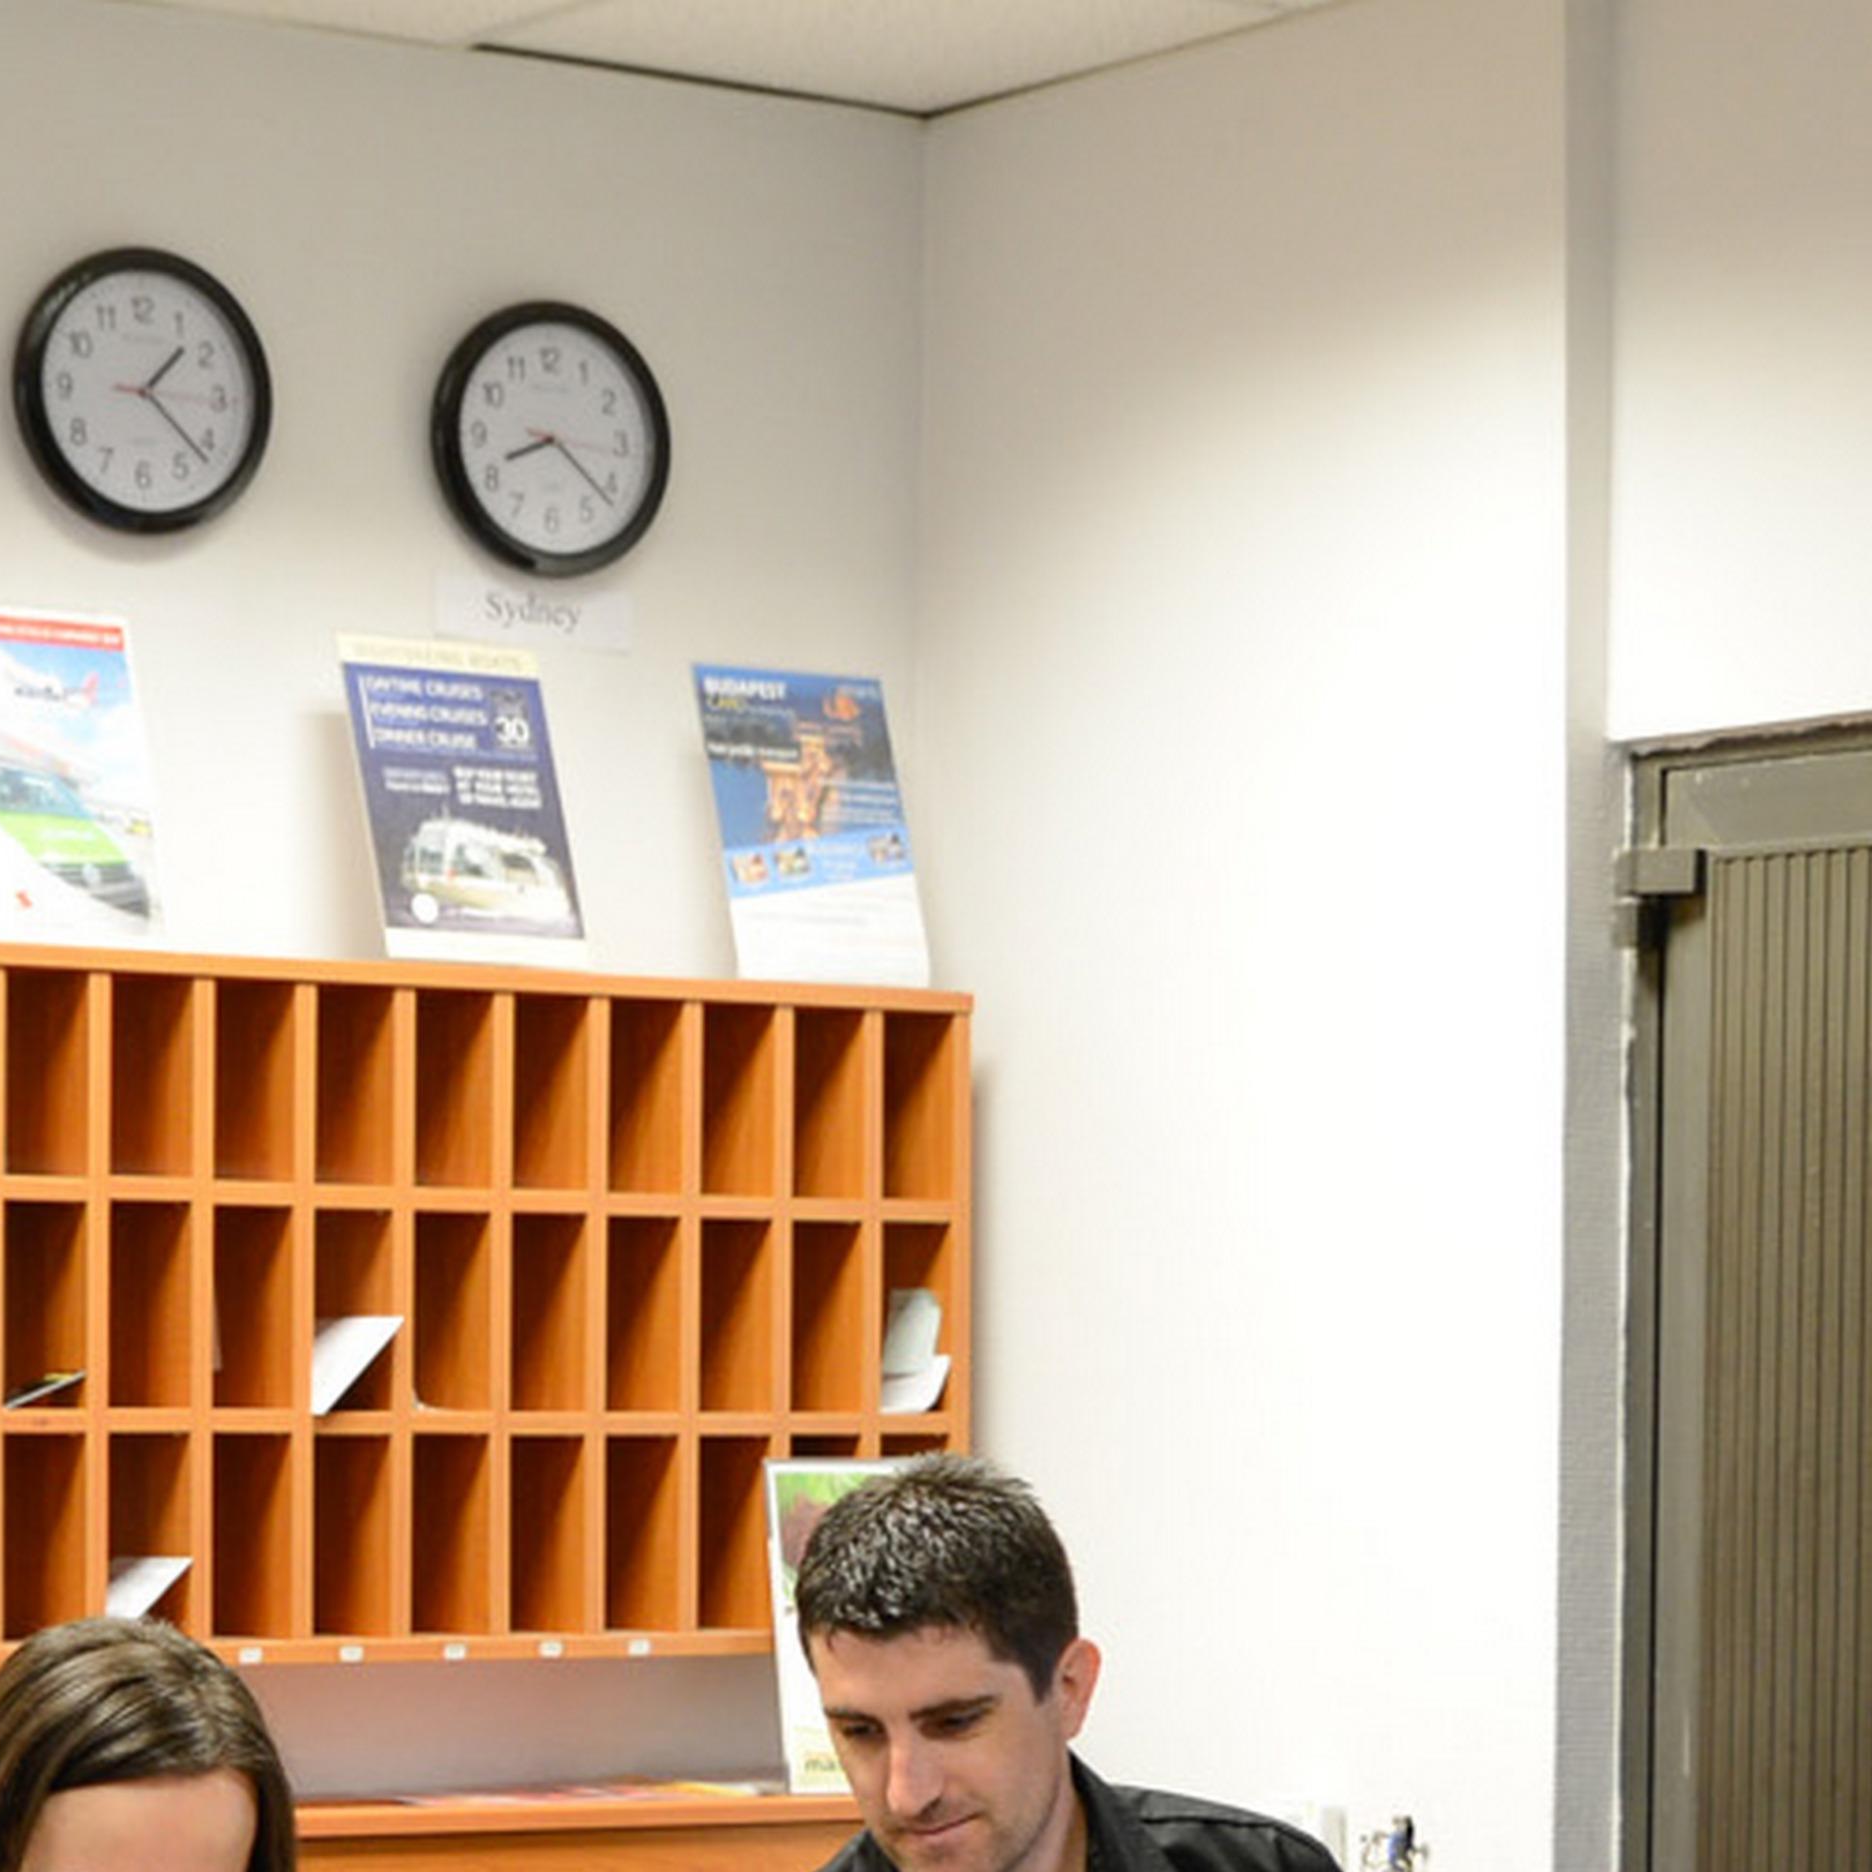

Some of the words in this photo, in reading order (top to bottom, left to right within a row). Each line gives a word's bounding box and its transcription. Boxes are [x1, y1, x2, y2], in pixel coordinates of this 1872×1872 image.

[96, 304, 117, 332] 11
[130, 296, 154, 324] 12
[174, 310, 184, 338] 1
[69, 330, 93, 359] 10
[197, 341, 215, 370] 2
[507, 355, 526, 381] 11
[539, 347, 562, 375] 12
[578, 359, 588, 386] 1
[57, 372, 74, 400] 9
[210, 384, 228, 413] 3
[482, 380, 506, 408] 10
[601, 388, 618, 416] 2
[69, 417, 88, 447] 8
[199, 427, 216, 452] 4
[470, 419, 488, 449] 9
[612, 430, 629, 459] 3
[98, 446, 114, 474] 7
[171, 452, 190, 481] 5
[134, 460, 152, 490] 6
[484, 463, 500, 492] 8
[604, 470, 619, 496] 4
[509, 490, 525, 517] 7
[579, 495, 595, 524] 5
[543, 505, 560, 534] 6
[484, 591, 582, 634] Sydney
[493, 715, 531, 743] 30
